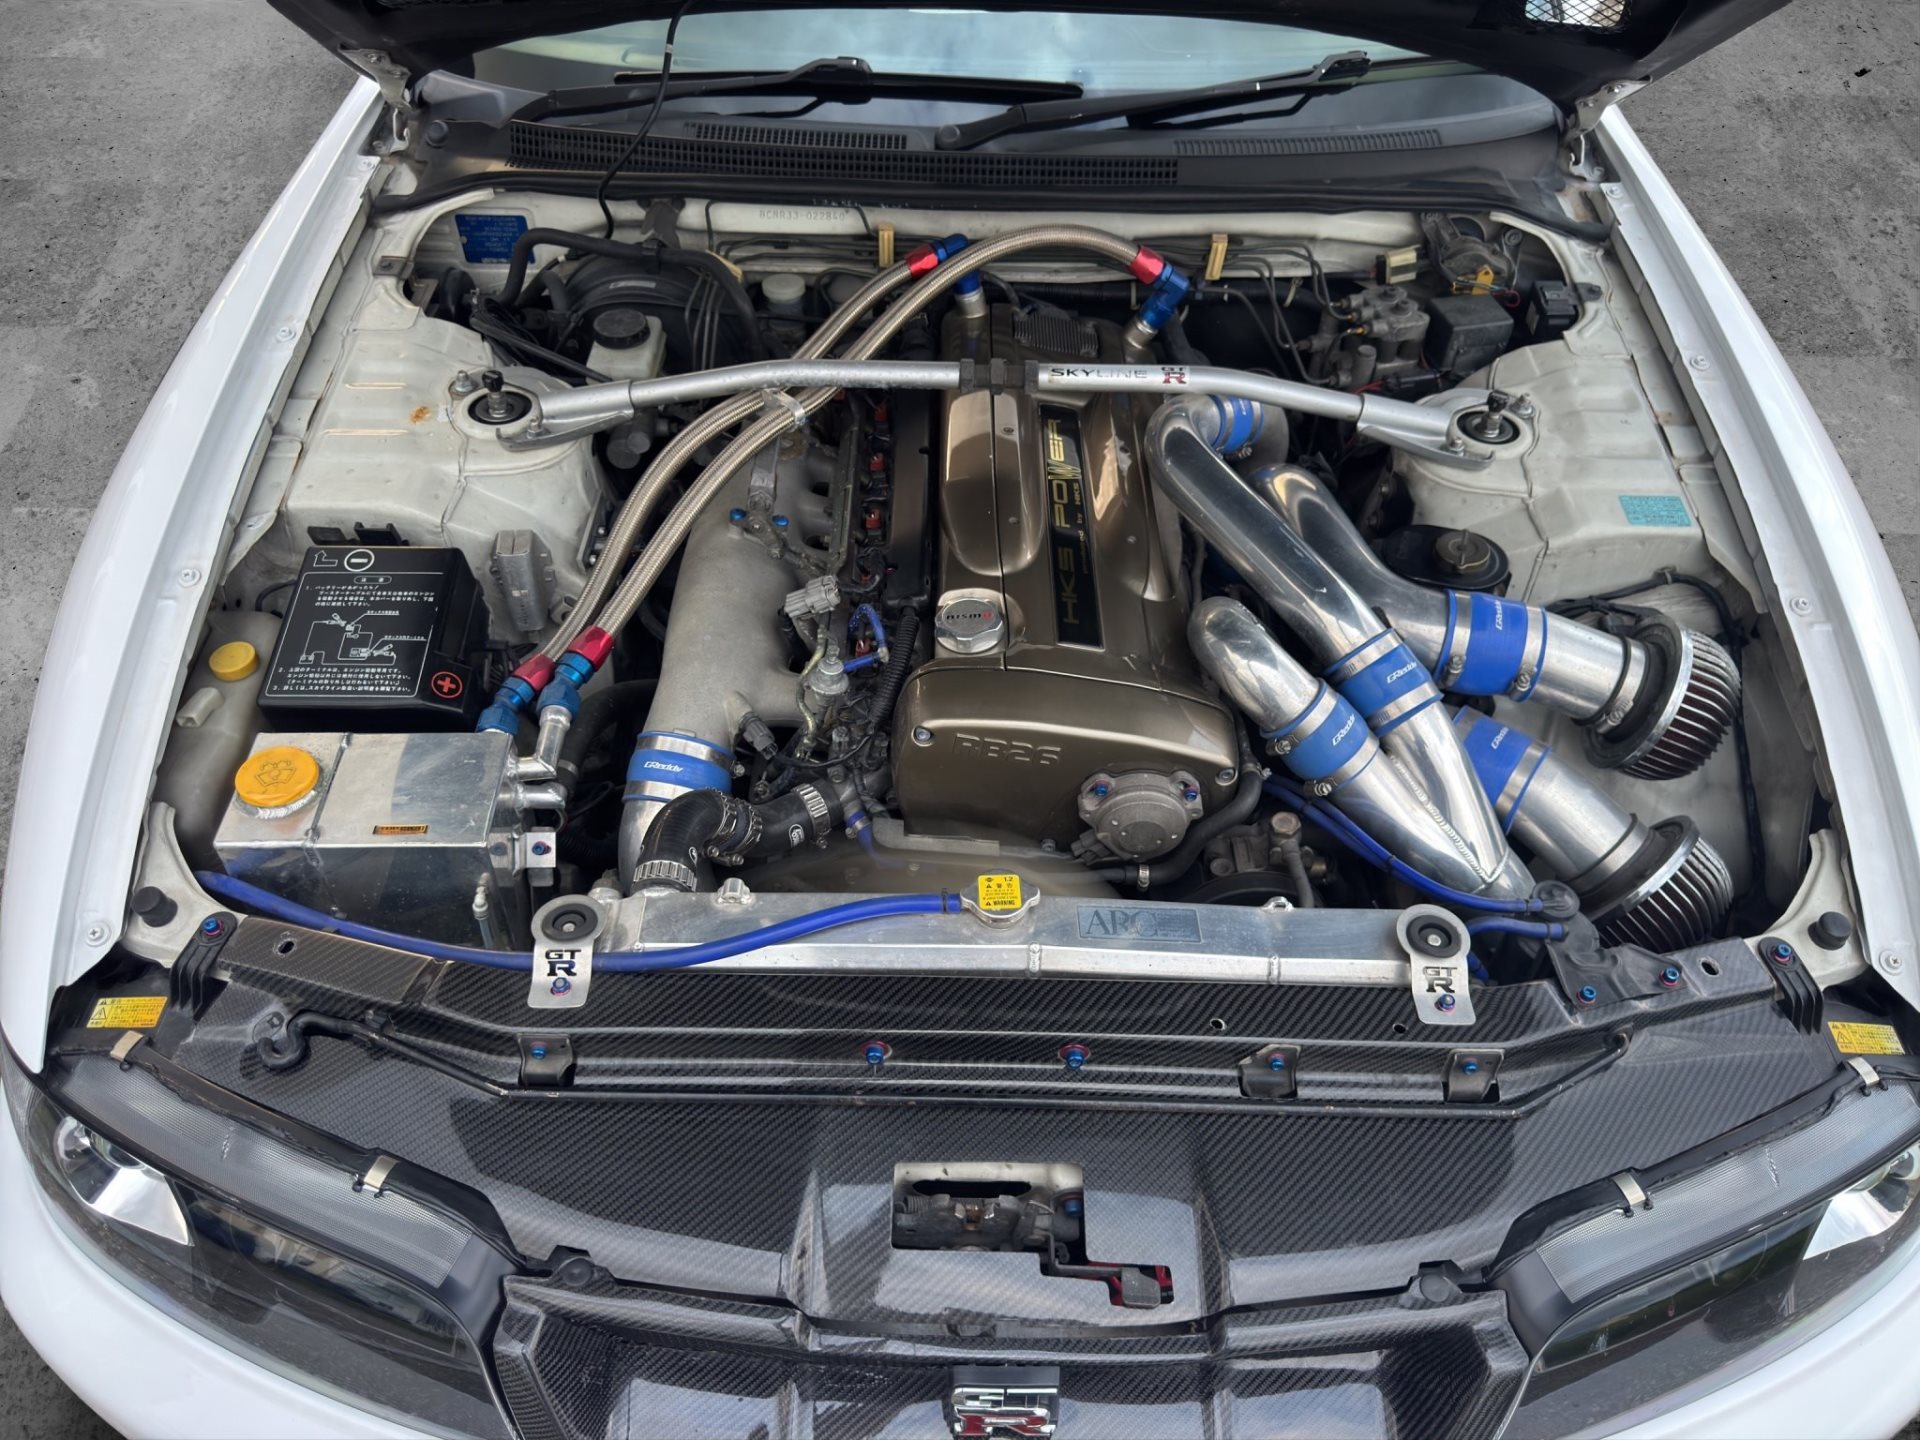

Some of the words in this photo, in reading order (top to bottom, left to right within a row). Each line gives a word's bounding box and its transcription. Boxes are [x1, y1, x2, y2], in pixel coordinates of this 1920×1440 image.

[1051, 367, 1147, 378] SKYLINE
[1047, 419, 1082, 528] POWER
[1058, 547, 1079, 624] HKS
[953, 732, 1062, 766] RB26
[644, 761, 683, 772] GReddy
[545, 949, 581, 959] GT
[547, 960, 577, 976] R
[1423, 966, 1457, 976] GT
[1425, 976, 1455, 993] R
